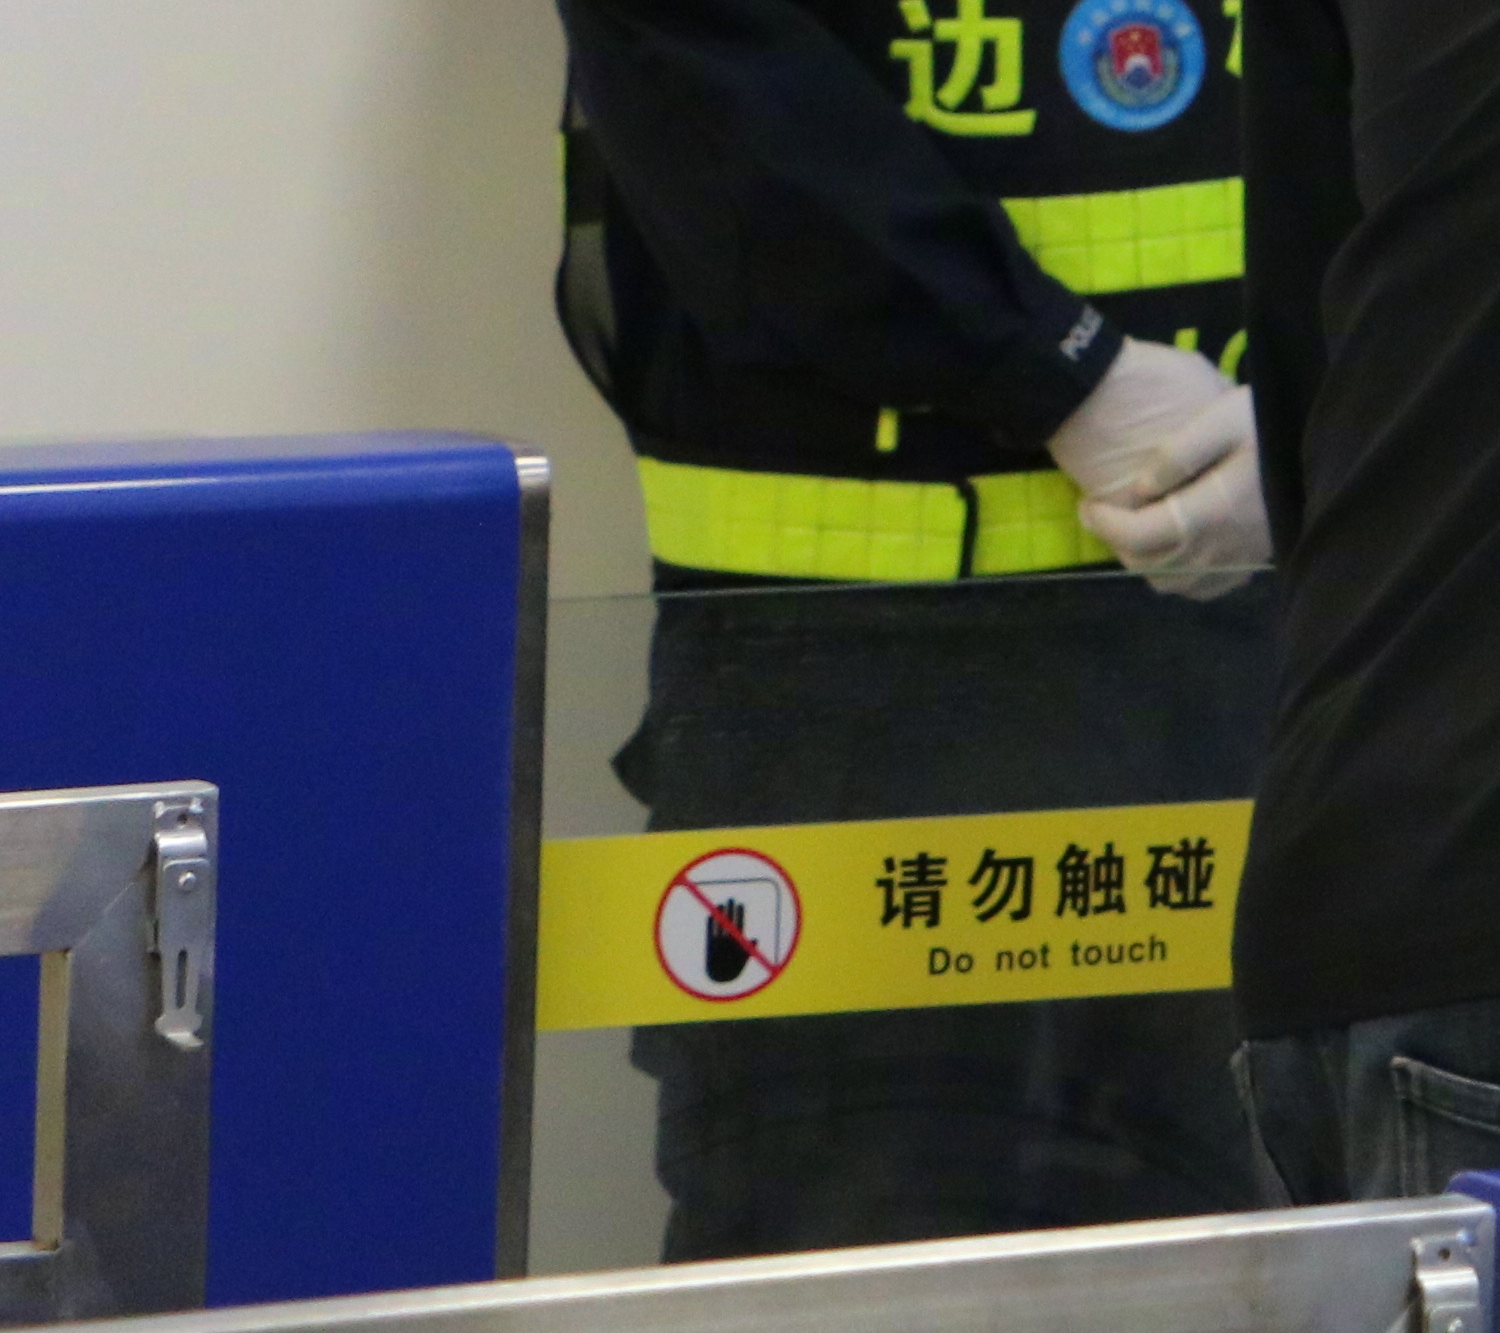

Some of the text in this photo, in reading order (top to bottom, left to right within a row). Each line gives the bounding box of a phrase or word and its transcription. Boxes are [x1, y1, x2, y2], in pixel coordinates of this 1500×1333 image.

[876, 836, 1214, 929] 请勿触碰
[928, 935, 1167, 975] Do not touch
